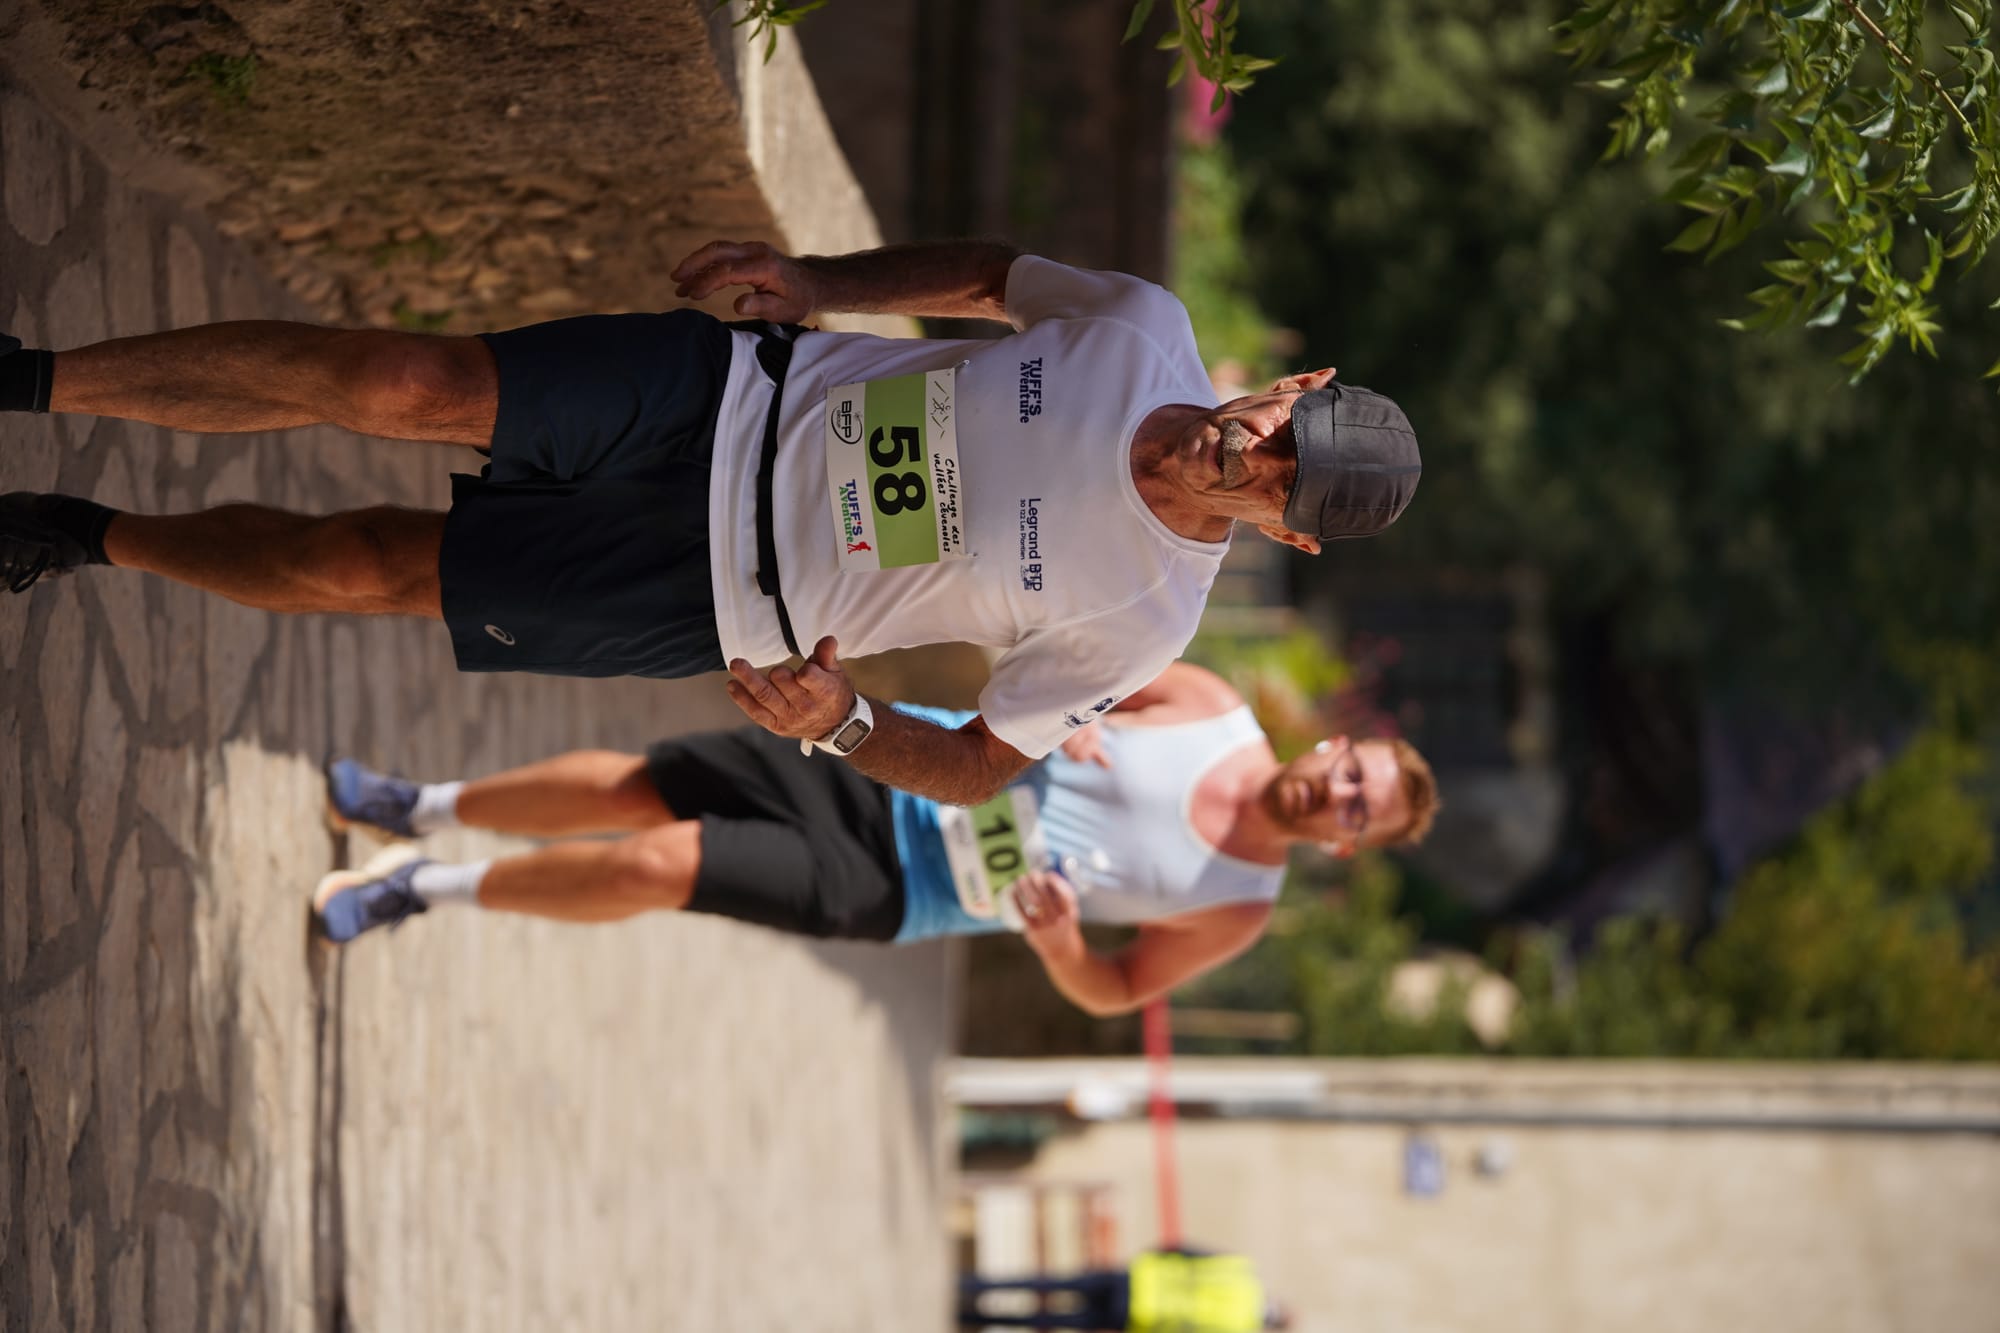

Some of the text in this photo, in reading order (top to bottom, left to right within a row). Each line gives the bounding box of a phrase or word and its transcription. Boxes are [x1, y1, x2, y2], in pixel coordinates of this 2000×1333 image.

[1020, 362, 1032, 423] Aventure
[1029, 357, 1042, 416] TUFF'S
[841, 400, 852, 438] BFP
[869, 426, 926, 516] 58
[934, 453, 947, 495] vallées
[839, 486, 853, 542] Aventure
[846, 479, 863, 536] TUFF'S
[945, 458, 960, 545] Challenge des
[1026, 498, 1042, 591] Legrand BTP
[978, 813, 1020, 894] 10
